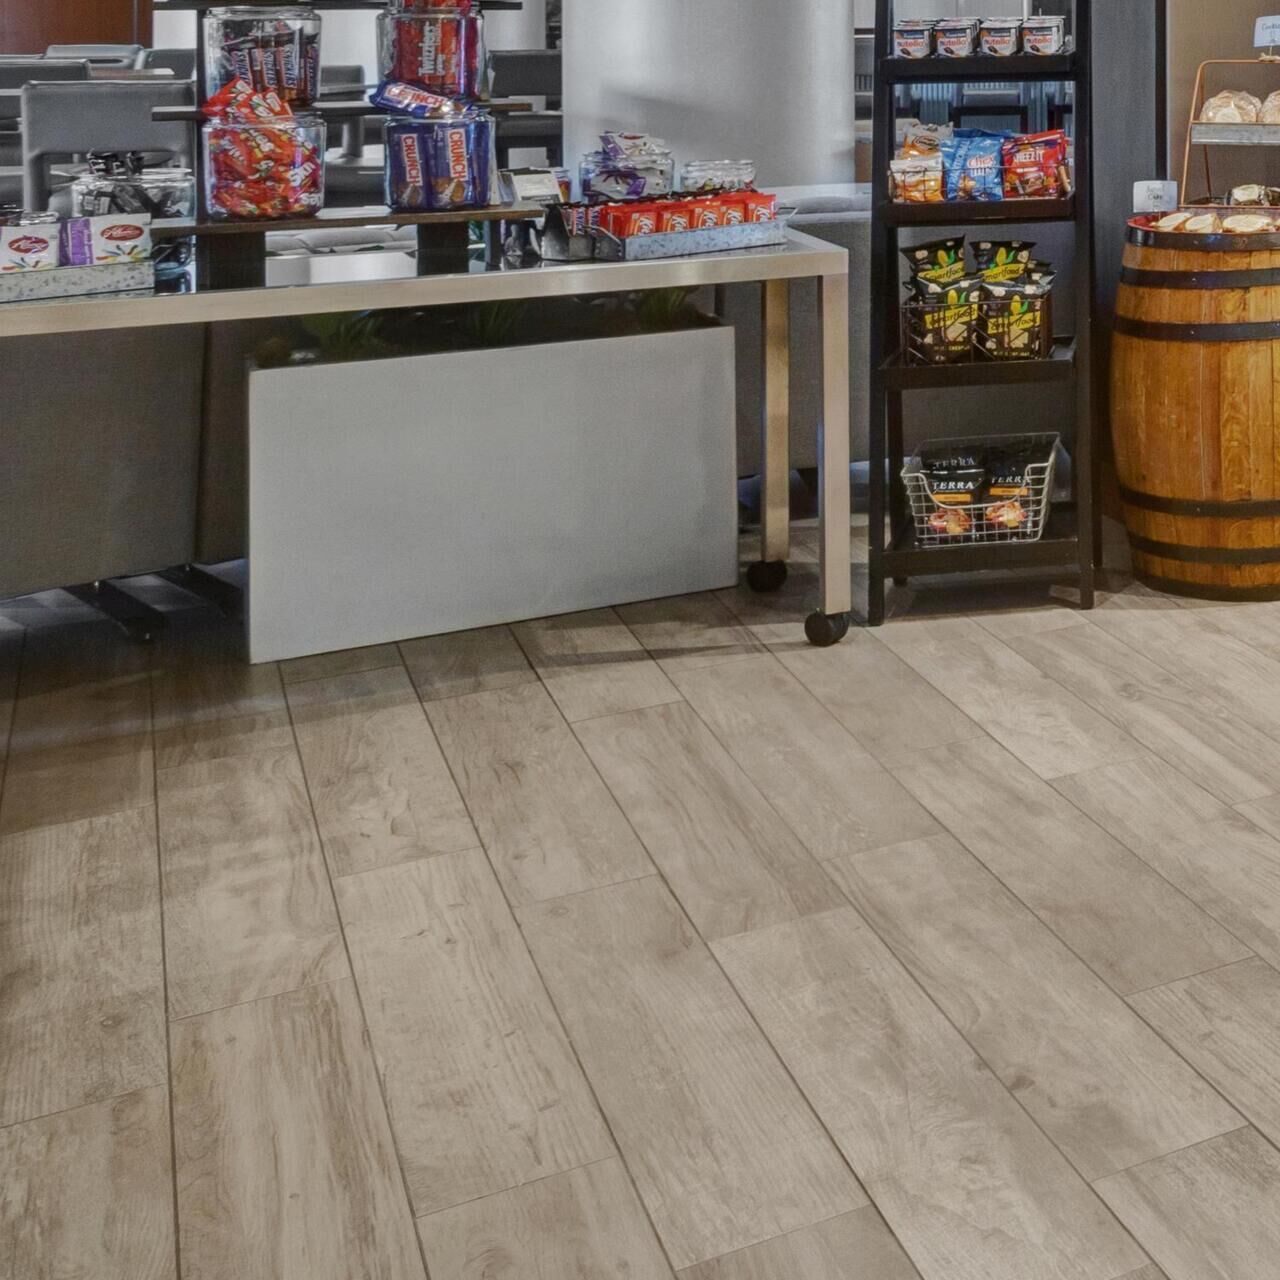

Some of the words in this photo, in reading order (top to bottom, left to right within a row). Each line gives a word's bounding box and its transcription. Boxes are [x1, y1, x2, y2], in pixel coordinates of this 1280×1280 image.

[283, 45, 298, 88] SNICKERS
[402, 135, 421, 185] CRUNCH
[448, 131, 466, 181] CRUNCH
[932, 481, 976, 491] TERRA
